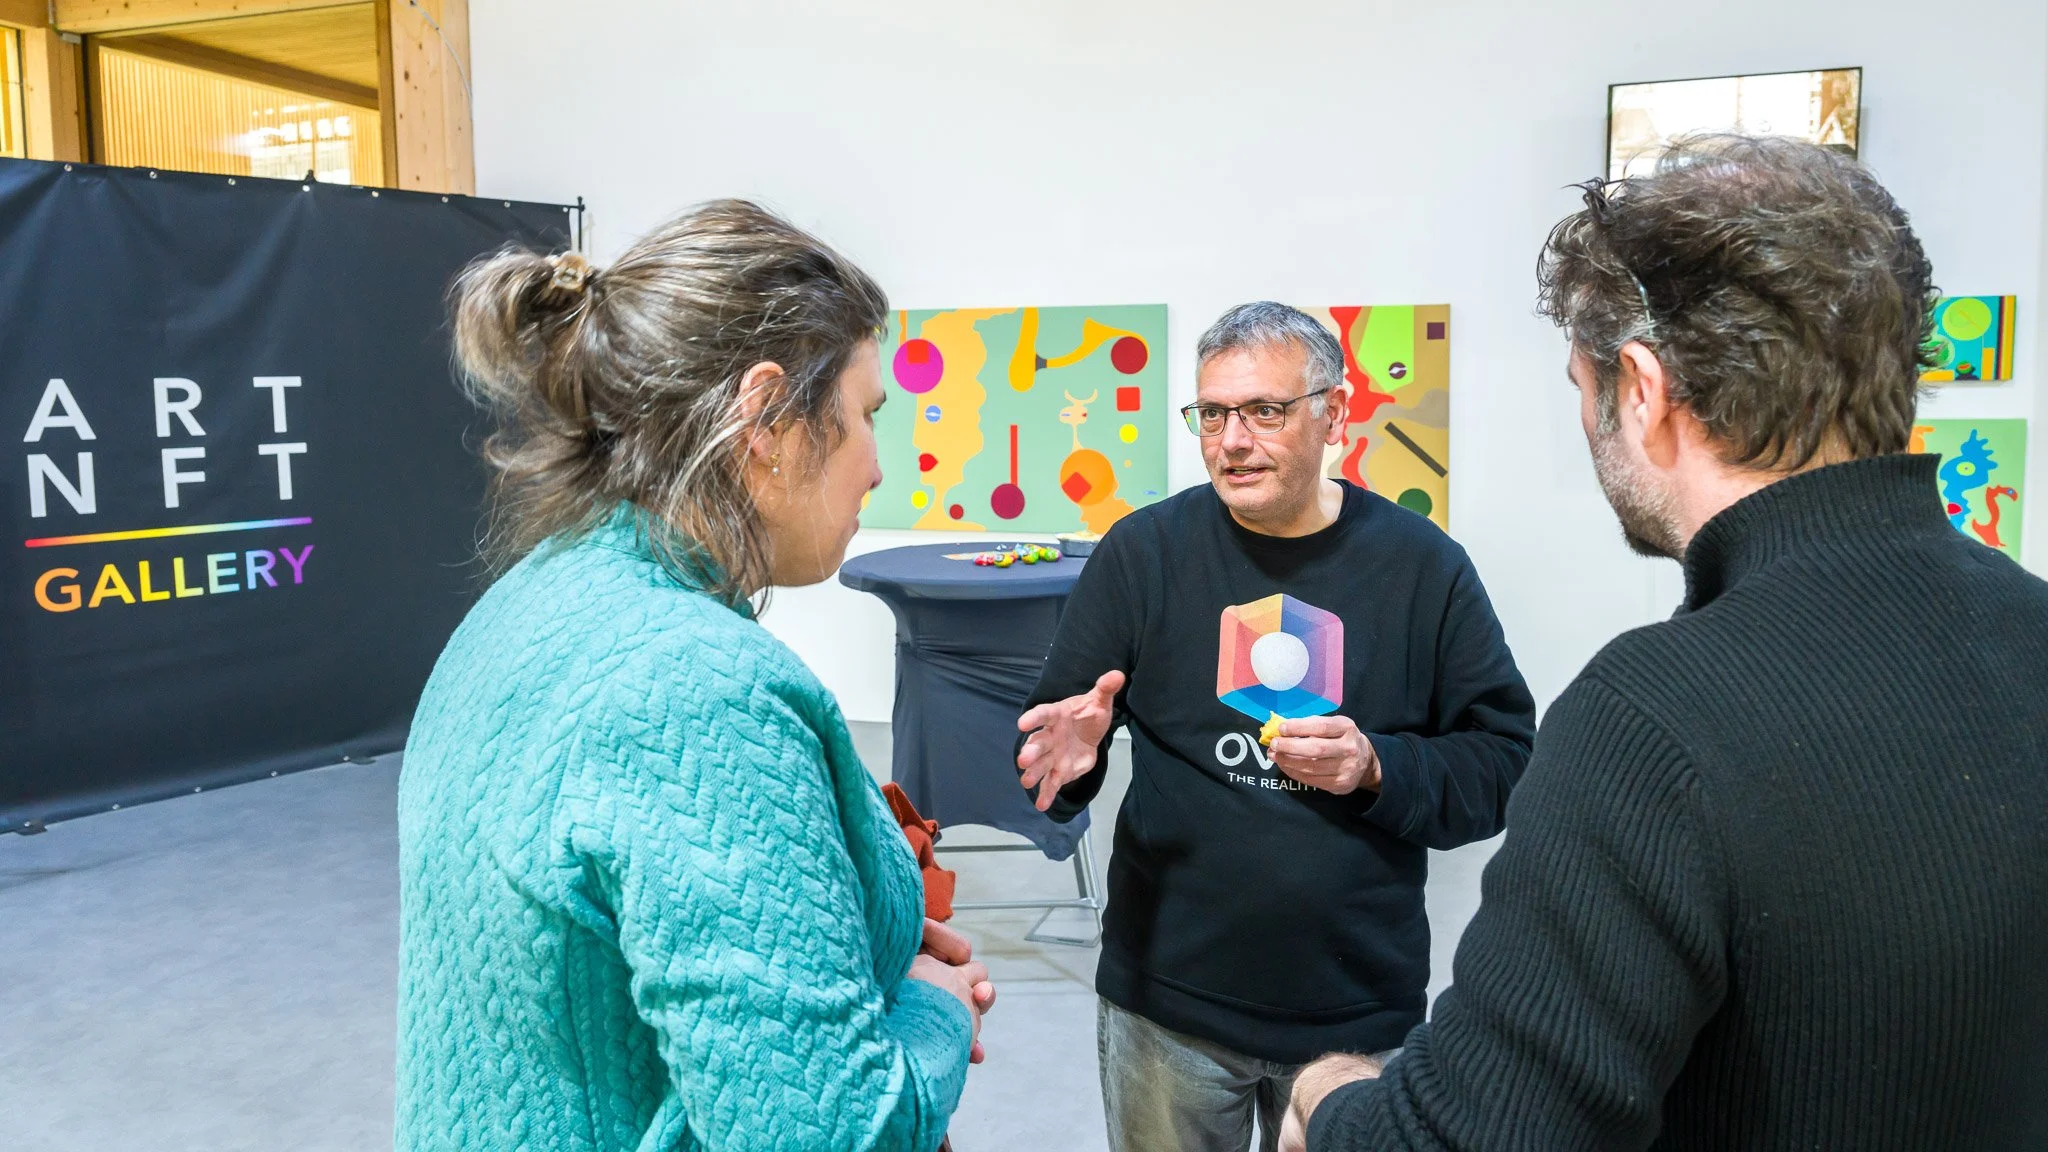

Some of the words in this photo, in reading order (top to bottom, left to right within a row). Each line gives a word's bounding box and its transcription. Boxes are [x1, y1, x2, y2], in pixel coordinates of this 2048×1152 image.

[23, 375, 303, 443] ART
[25, 441, 308, 519] NFT
[34, 544, 315, 613] GALLERY
[1215, 732, 1275, 770] OV
[1227, 772, 1256, 786] THE
[1260, 778, 1317, 791] REALI
